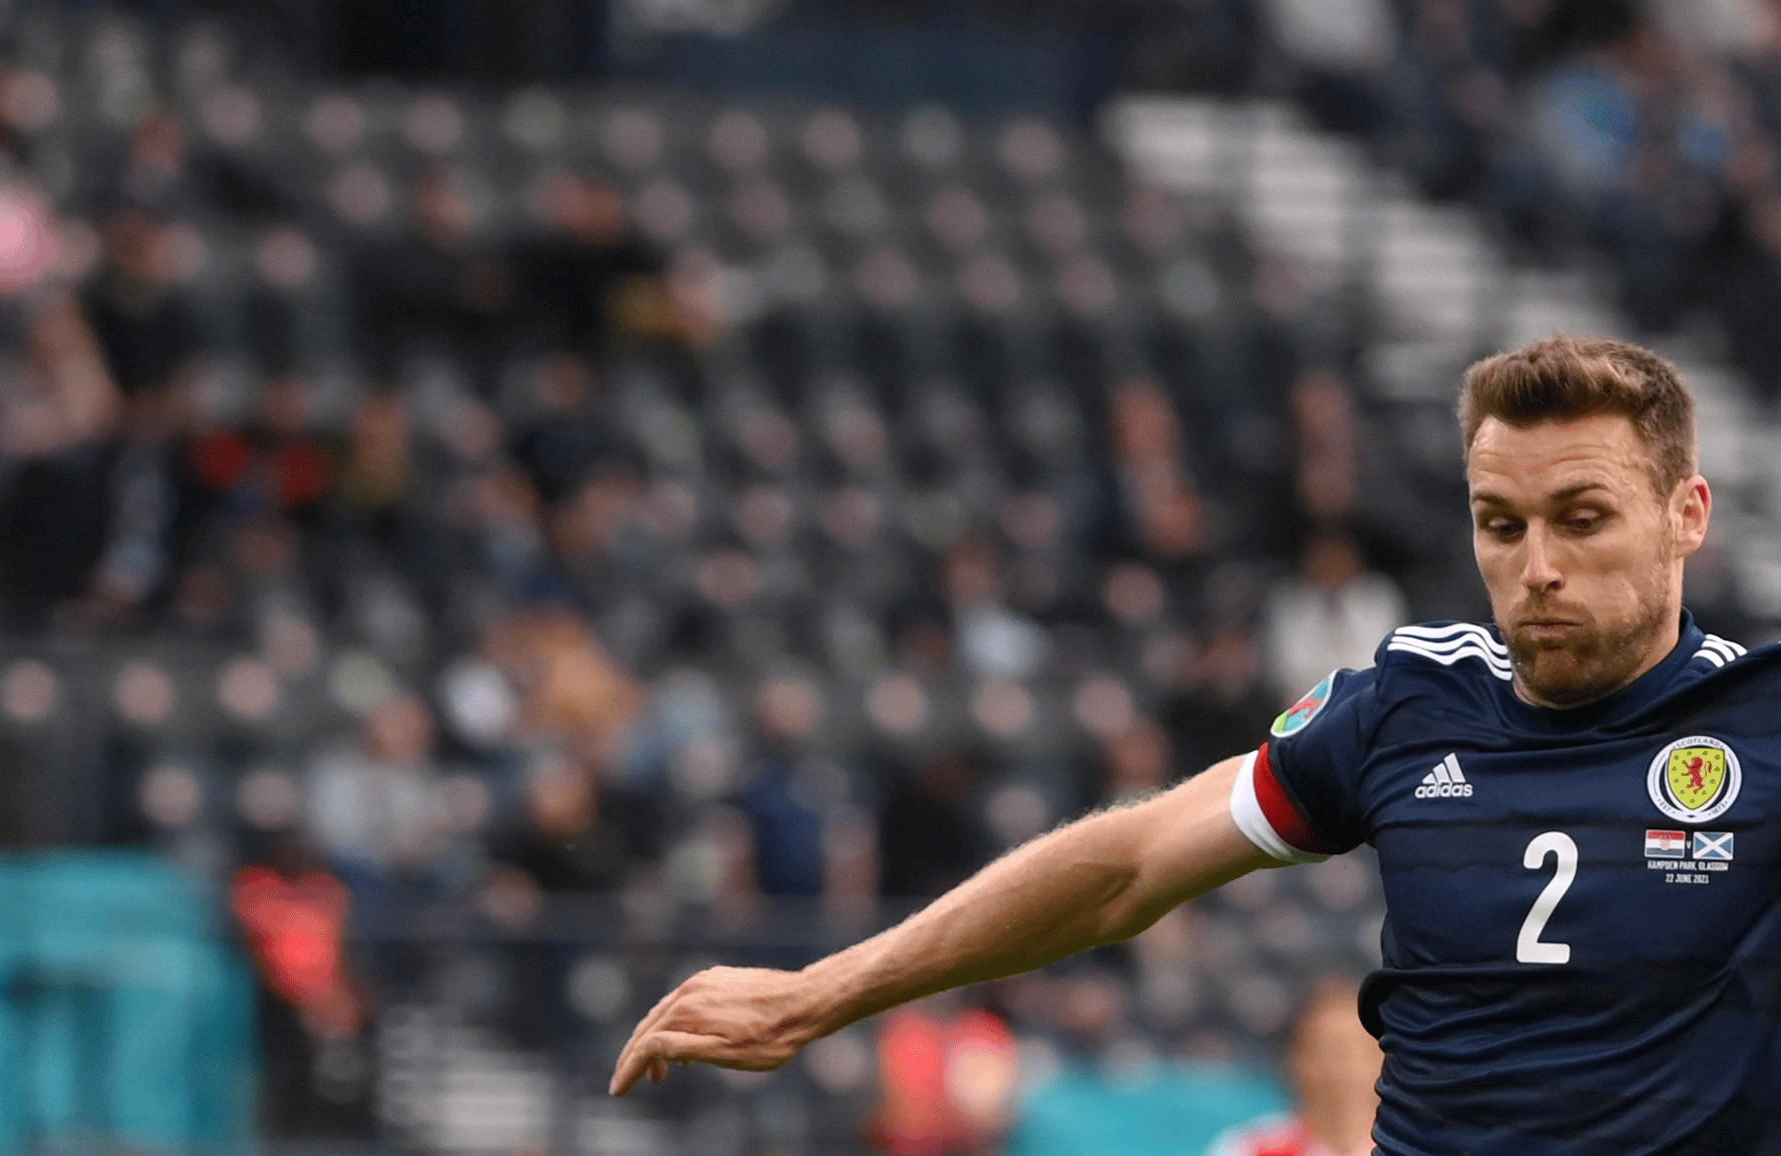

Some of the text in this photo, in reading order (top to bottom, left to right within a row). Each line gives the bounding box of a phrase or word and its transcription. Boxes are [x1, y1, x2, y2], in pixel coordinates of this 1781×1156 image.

[1675, 738, 1721, 748] SCOTLAND
[1414, 781, 1474, 799] adidas
[1647, 860, 1679, 870] HAMPDEN
[1698, 861, 1729, 871] GLASGOW
[1665, 873, 1709, 884] 22 JUNE 2021
[1516, 831, 1579, 965] 2
